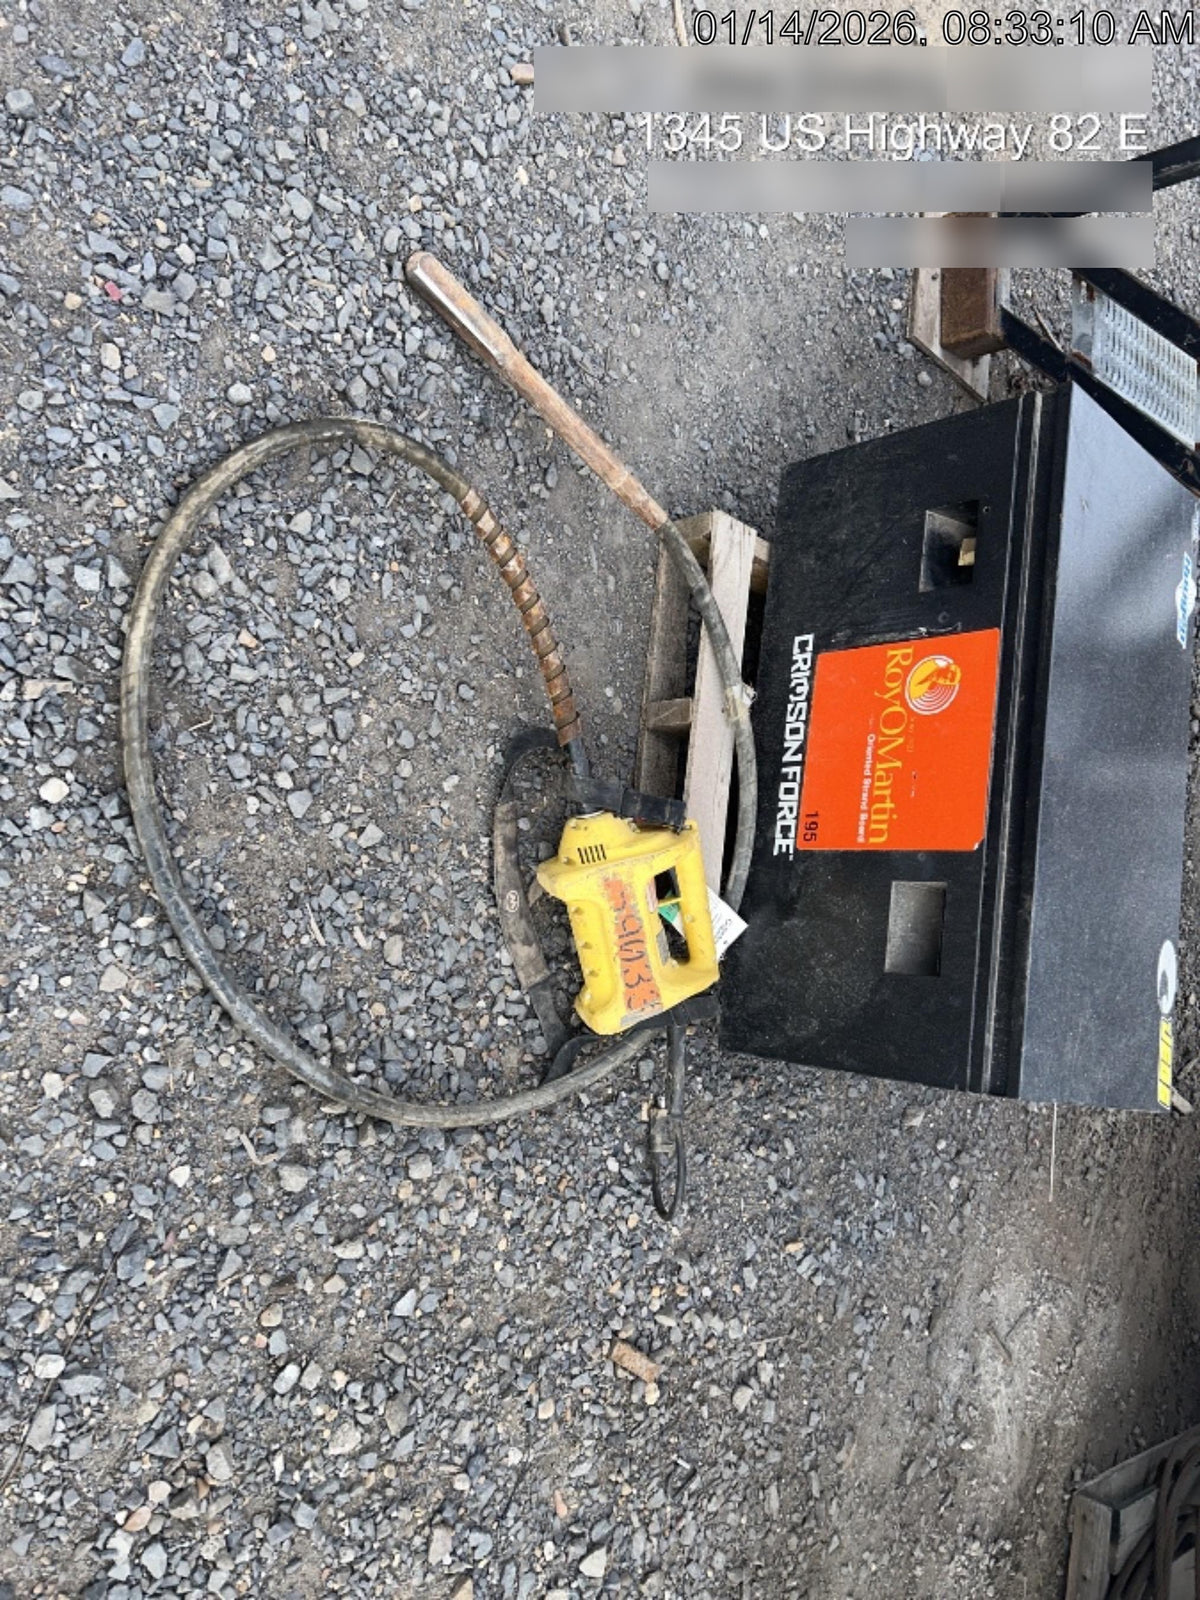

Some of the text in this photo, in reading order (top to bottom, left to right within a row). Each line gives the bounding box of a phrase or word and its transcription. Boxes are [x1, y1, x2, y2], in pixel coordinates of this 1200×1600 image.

[773, 633, 815, 856] CRIMSON FORCE
[803, 810, 819, 842] 195
[869, 646, 914, 844] RoyOMartin
